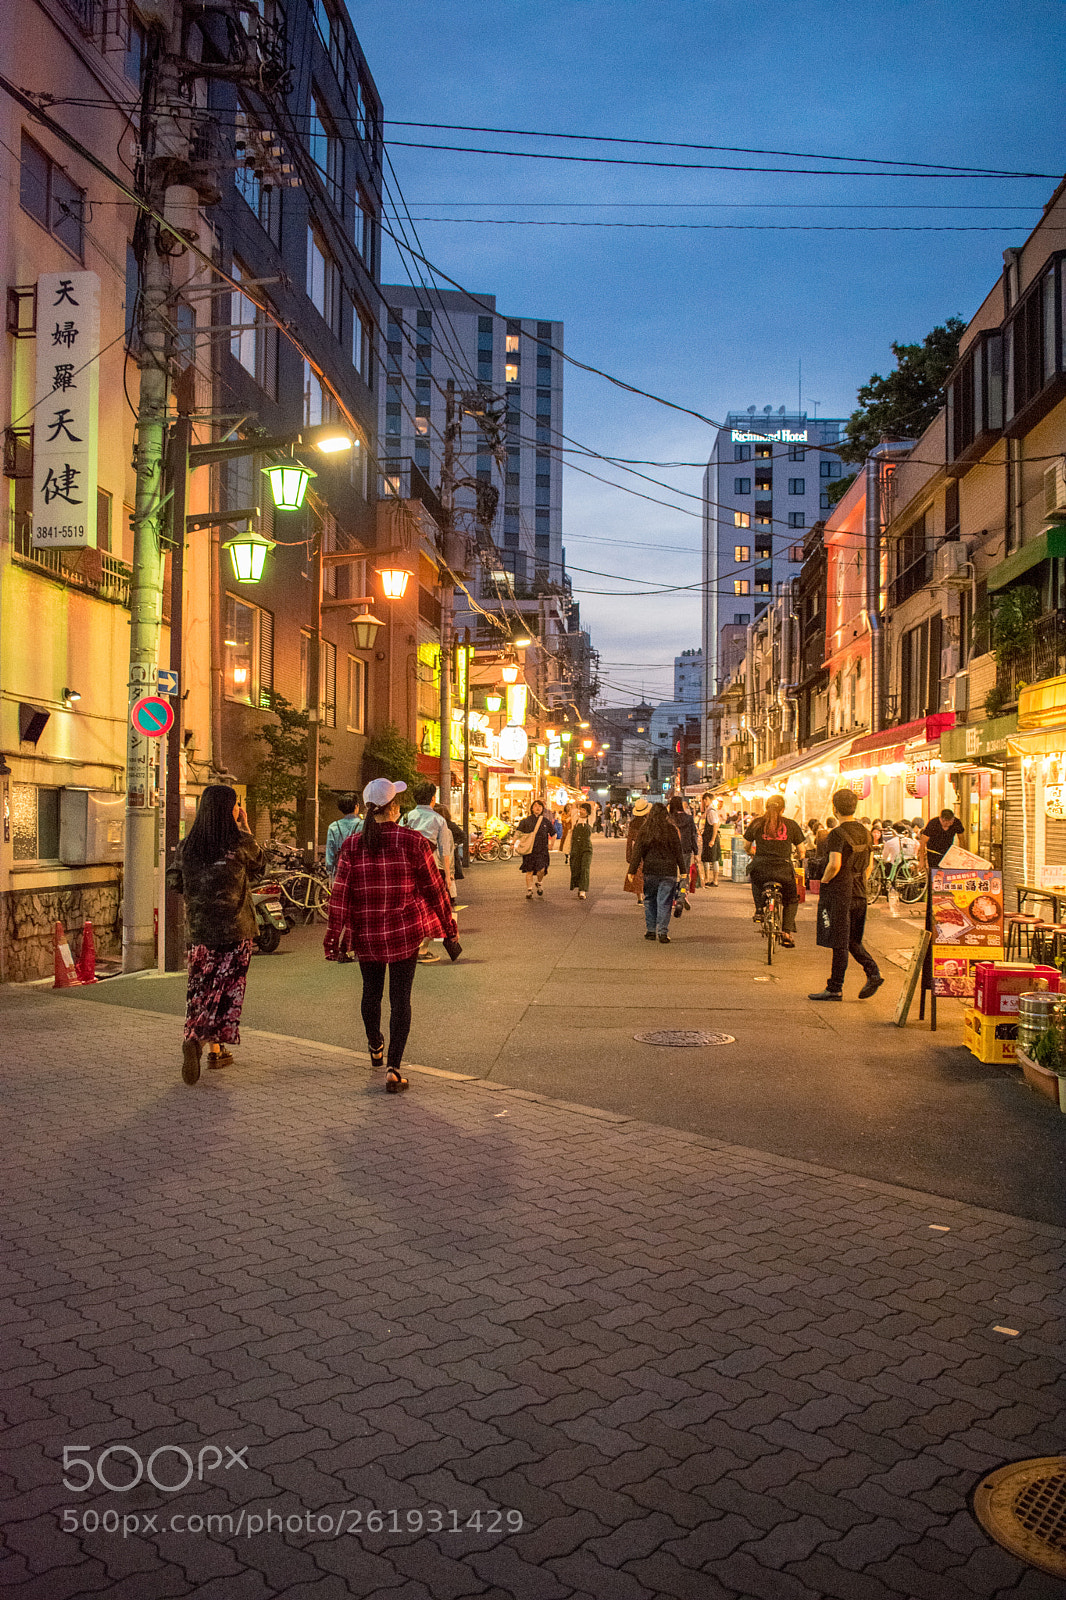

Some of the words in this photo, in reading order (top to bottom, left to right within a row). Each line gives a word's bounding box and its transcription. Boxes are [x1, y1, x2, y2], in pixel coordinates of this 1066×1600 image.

[39, 279, 84, 506] 天婦羅天健
[781, 429, 807, 442] Hotel
[36, 525, 84, 539] 3841-5519
